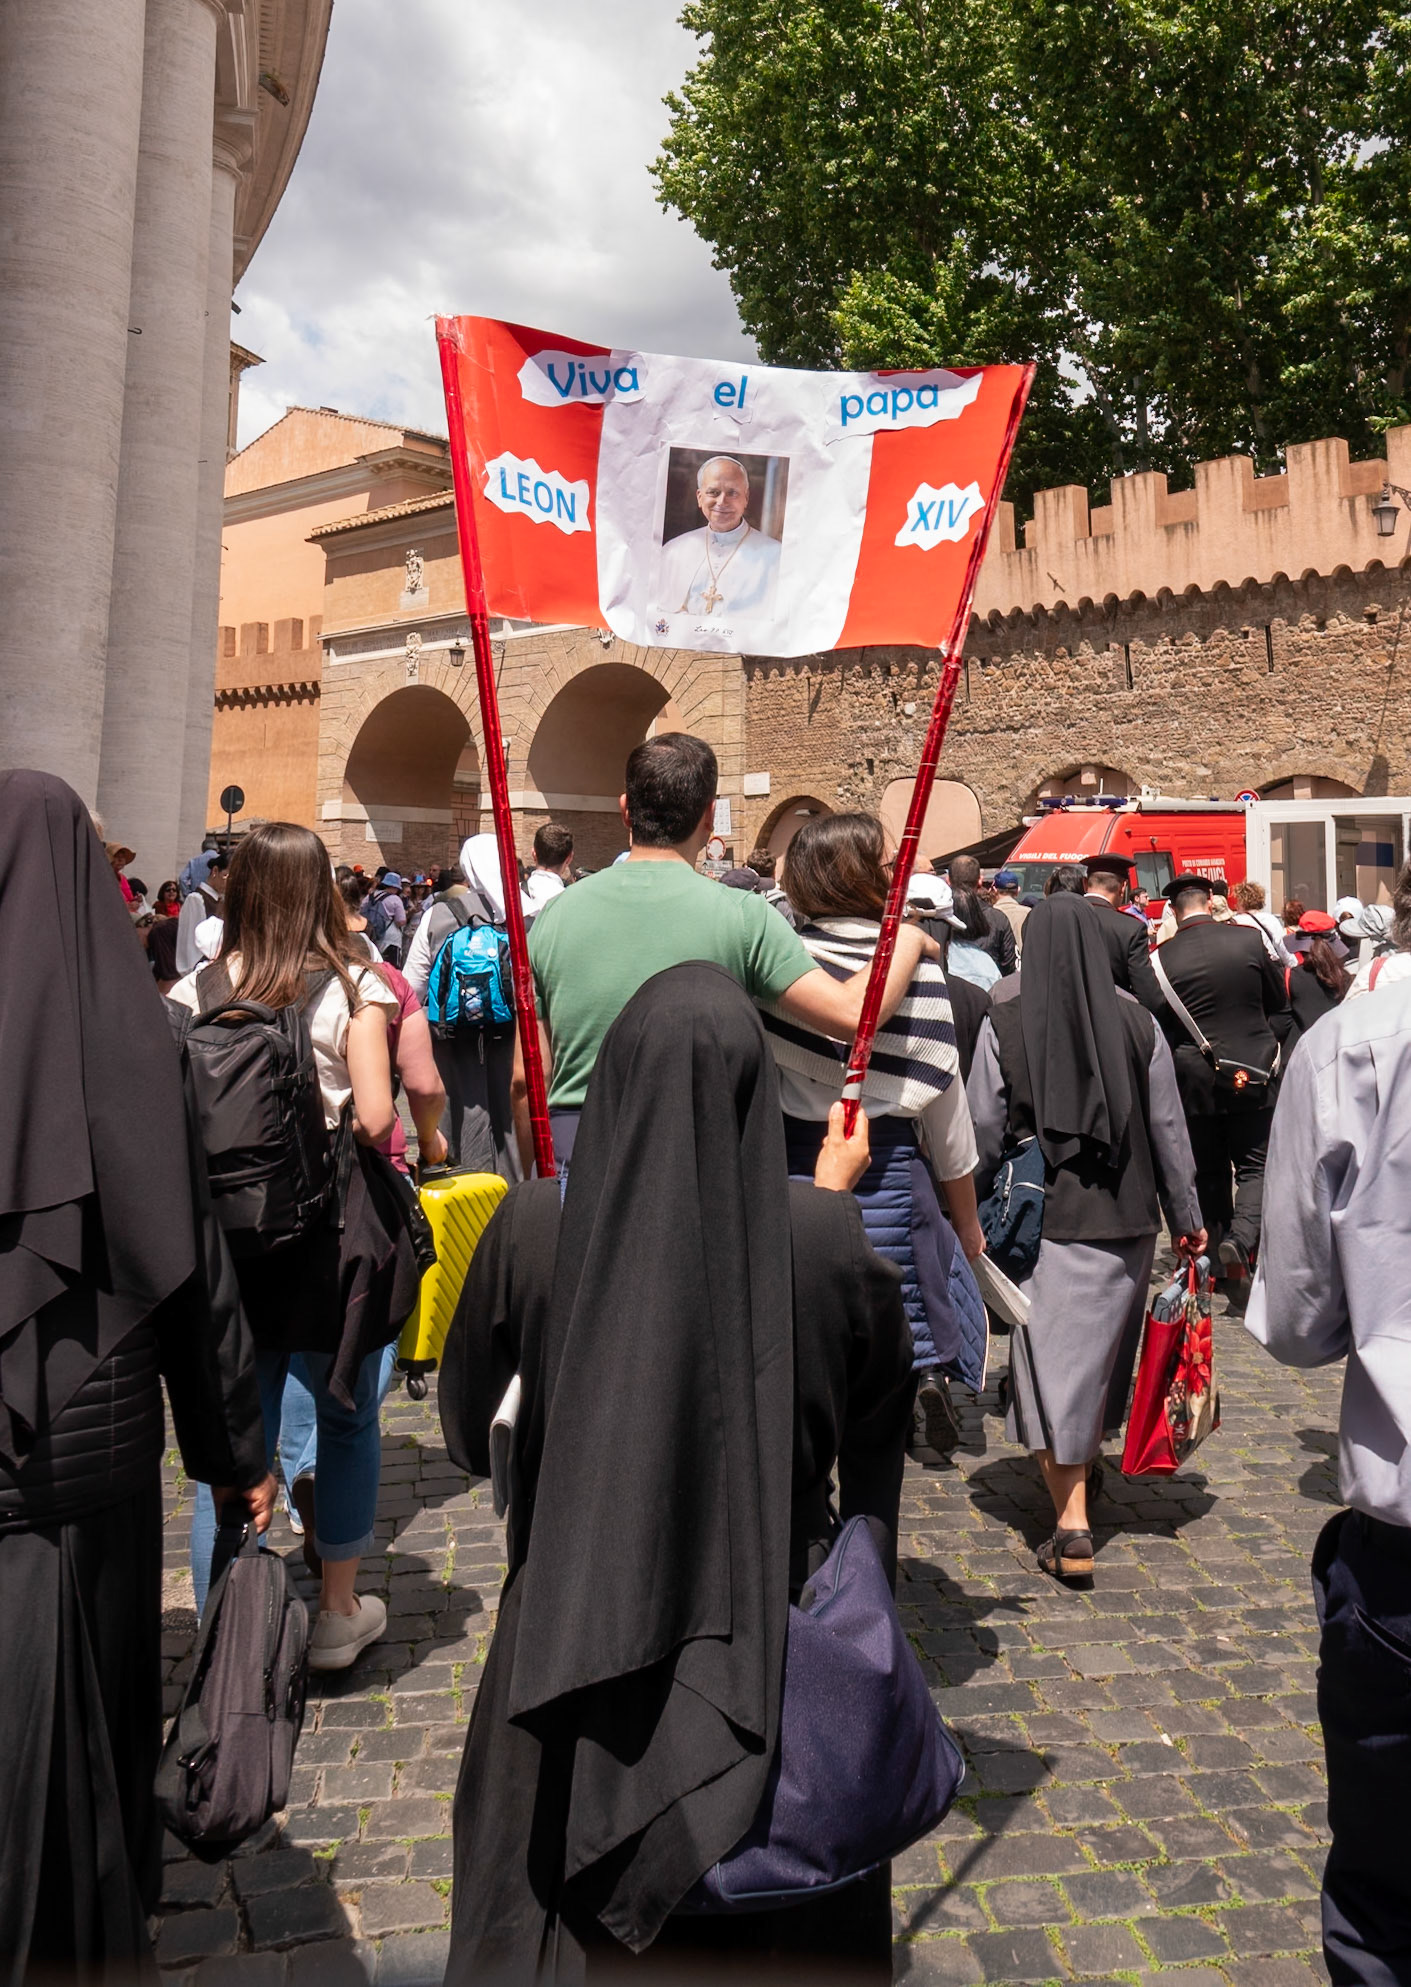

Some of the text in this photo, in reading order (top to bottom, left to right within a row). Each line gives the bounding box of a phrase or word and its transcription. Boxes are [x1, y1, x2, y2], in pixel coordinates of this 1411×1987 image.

[547, 361, 939, 427] Viva el papa
[499, 466, 970, 532] LEON XIV
[1018, 852, 1042, 860] VIGILI
[1042, 852, 1058, 860] DEL
